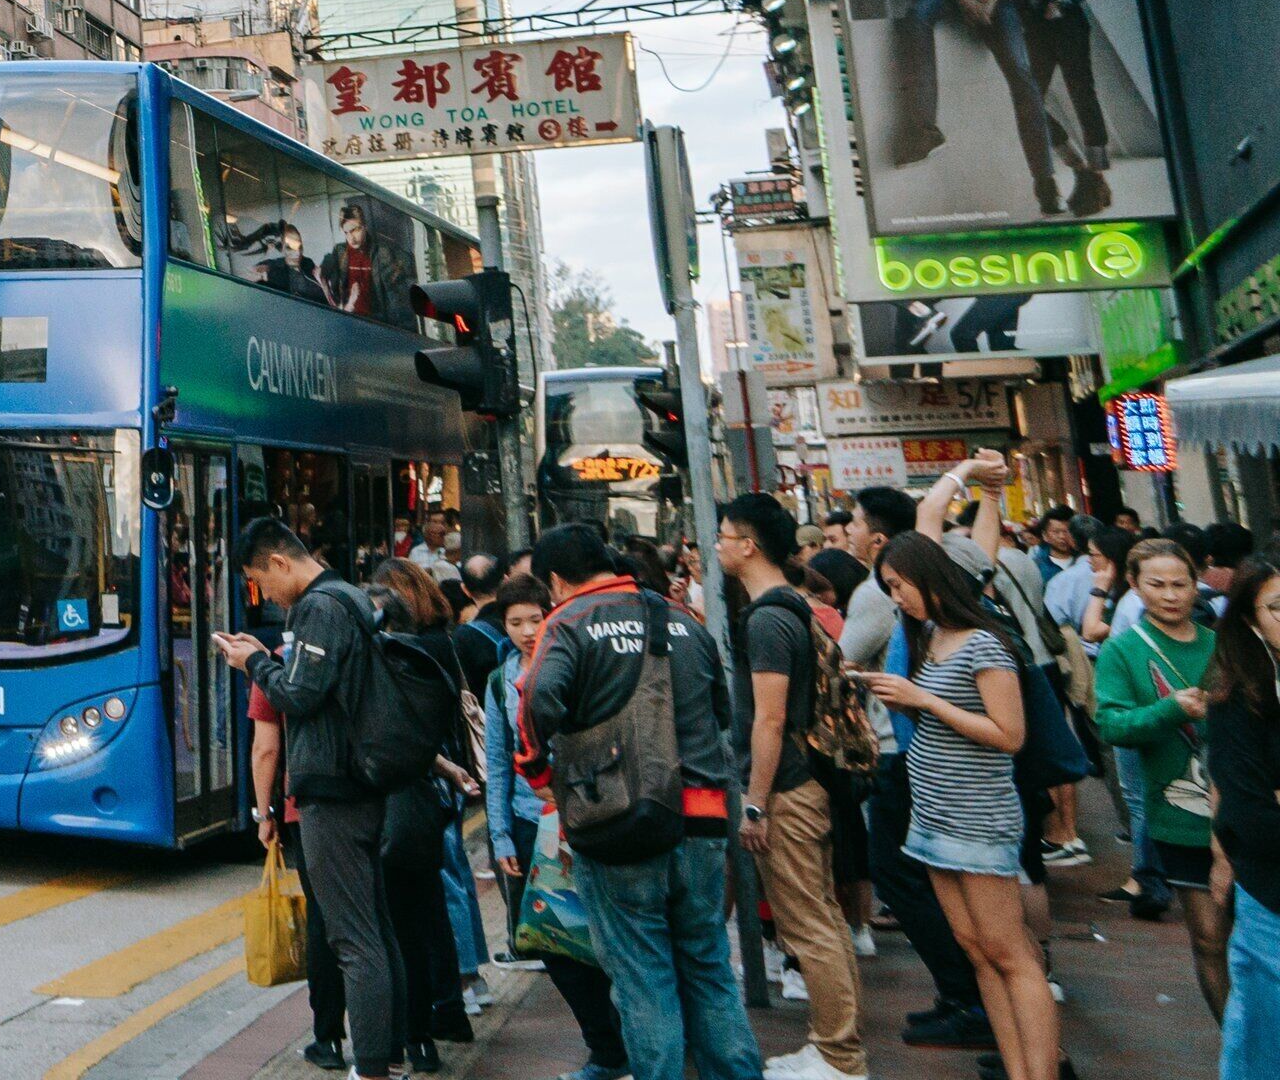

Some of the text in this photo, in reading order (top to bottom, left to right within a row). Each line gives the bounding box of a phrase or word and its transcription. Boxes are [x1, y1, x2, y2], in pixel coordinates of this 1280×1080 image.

[326, 45, 604, 116] 皇都賓館
[359, 99, 580, 131] WONG TOA HOTEL
[874, 238, 1079, 292] bossini
[246, 335, 338, 403] CALVIN KLEIN
